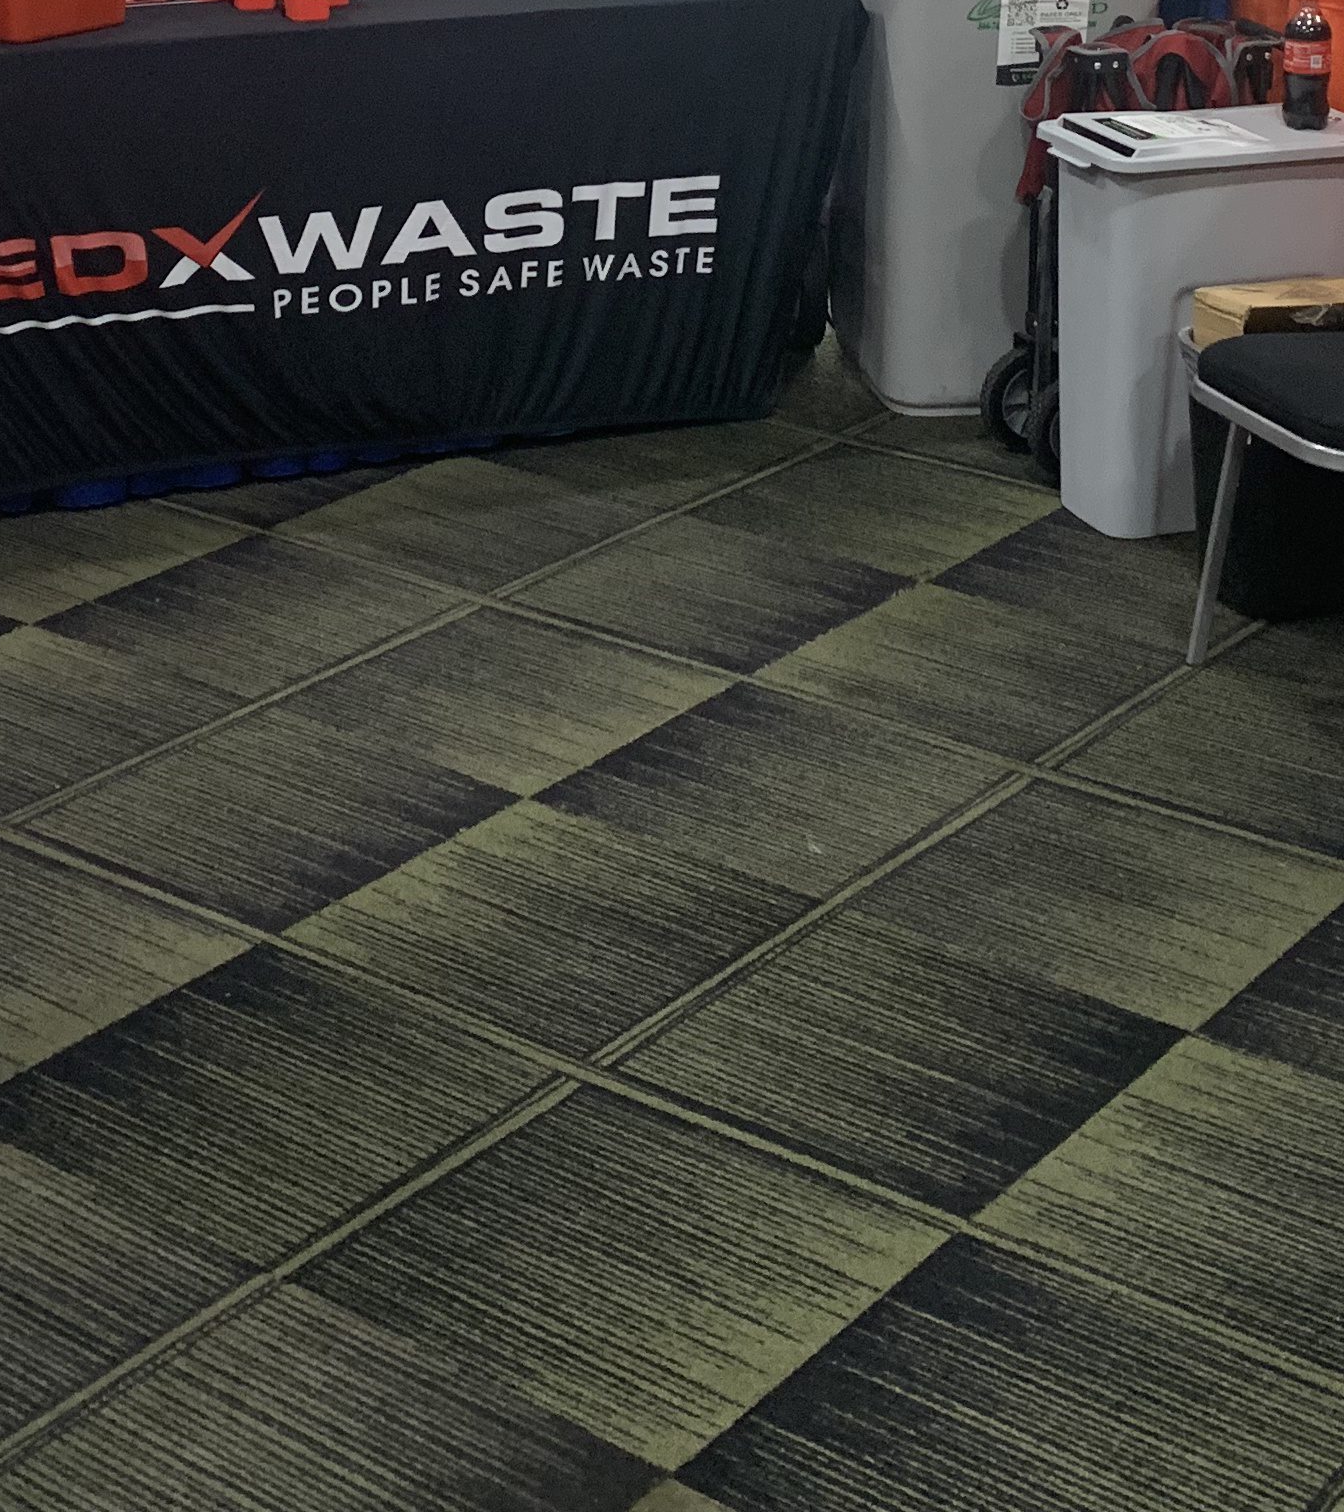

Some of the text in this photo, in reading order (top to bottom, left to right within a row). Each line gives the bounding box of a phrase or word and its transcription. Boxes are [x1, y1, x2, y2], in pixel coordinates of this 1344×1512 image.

[272, 246, 714, 319] PEOPLE SAFE WASTE
